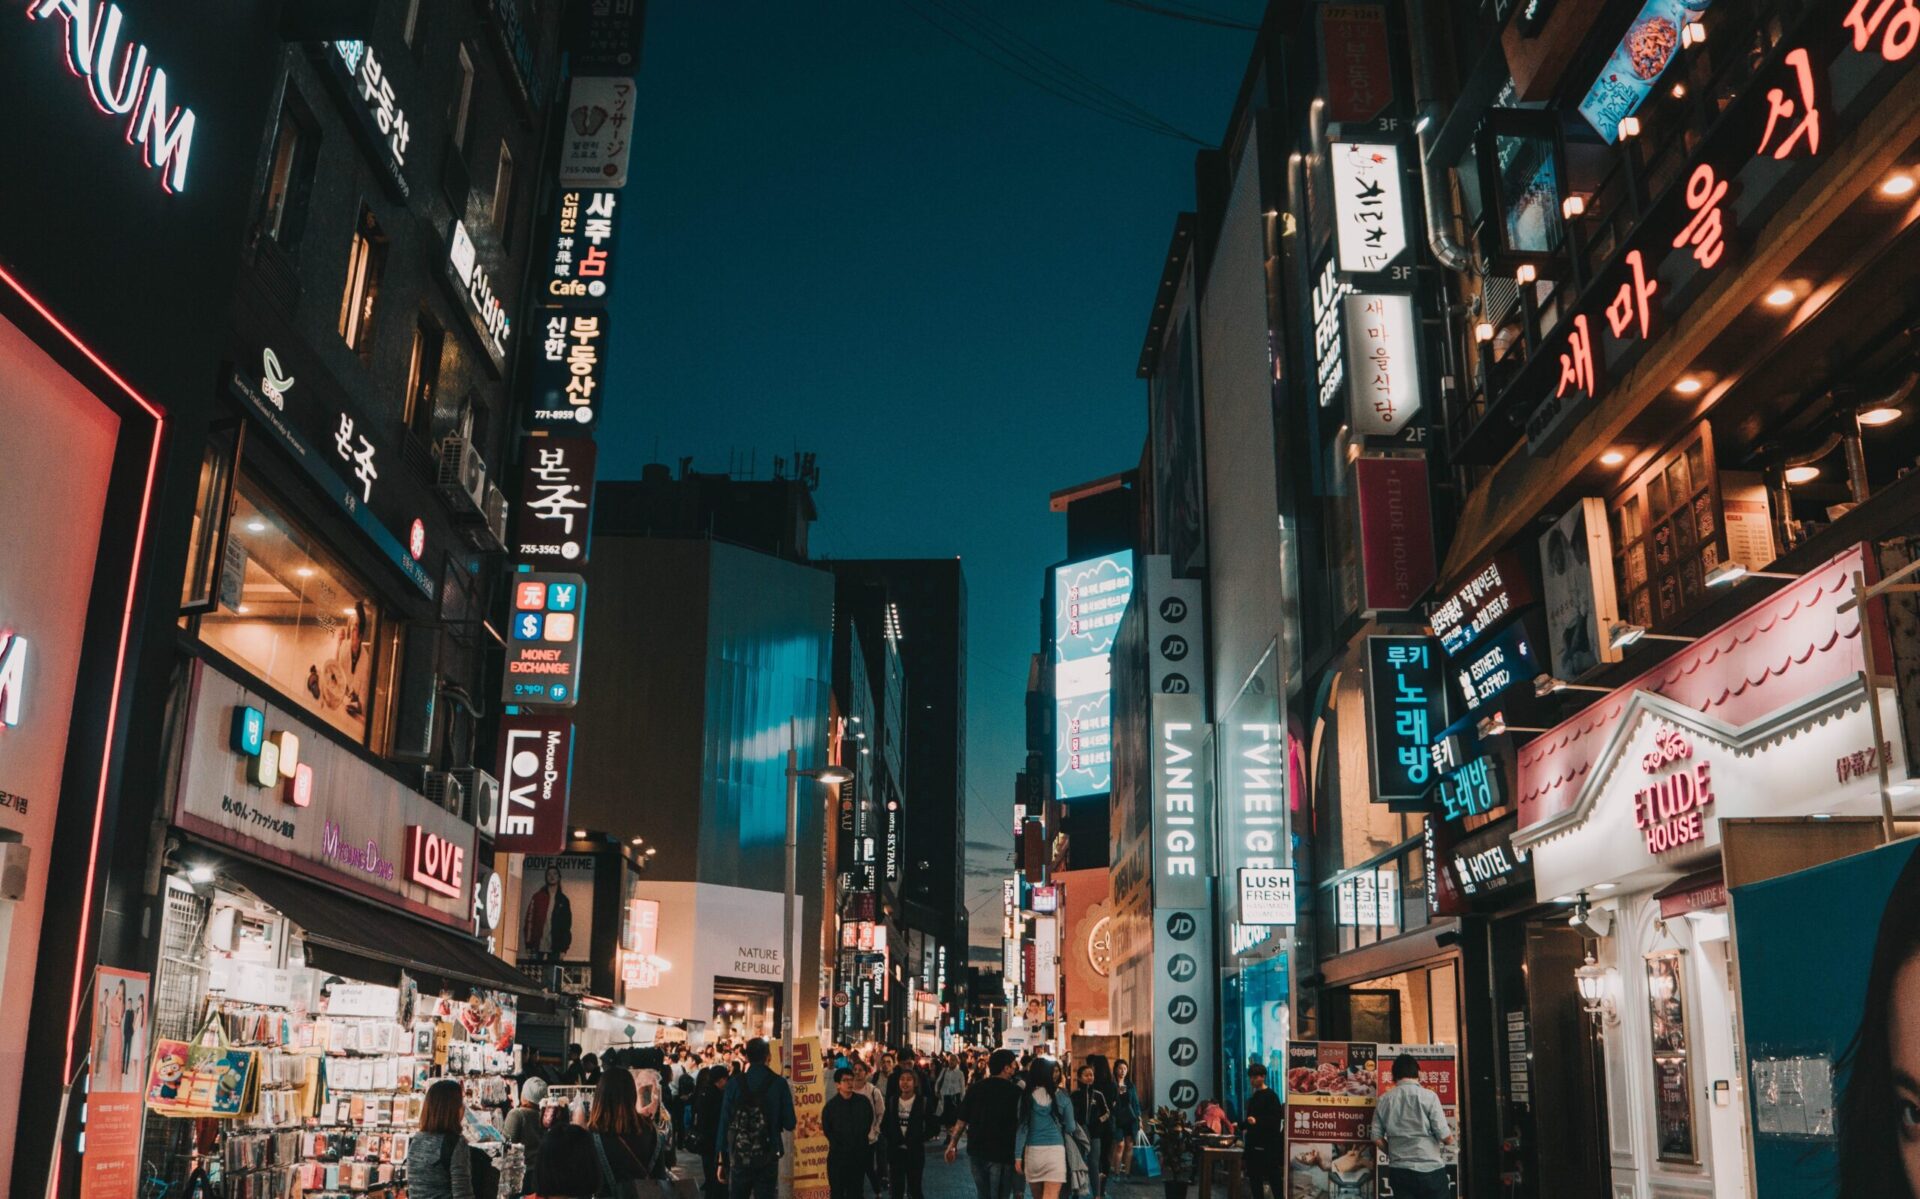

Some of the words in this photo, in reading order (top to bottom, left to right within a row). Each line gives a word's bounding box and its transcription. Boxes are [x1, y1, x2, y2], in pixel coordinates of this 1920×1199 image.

[361, 45, 410, 167] 부동산
[606, 84, 630, 159] マッサージ
[1379, 118, 1398, 131] 3F
[560, 193, 580, 234] 신비안
[1391, 266, 1412, 280] 3F
[549, 279, 586, 296] Cafe
[544, 317, 567, 361] 신한
[566, 317, 600, 405] 부동산
[1365, 299, 1396, 422] 새마을식당
[1406, 427, 1426, 441] 2F
[334, 412, 378, 504] 본죽
[526, 448, 588, 535] 본죽
[520, 543, 561, 555] 755-3562
[1164, 603, 1184, 617] JD
[520, 648, 561, 662] MONEY
[1164, 640, 1185, 655] JD
[1387, 646, 1428, 669] 루키
[1470, 646, 1505, 680] ESTHETIC
[510, 661, 570, 675] EXCHANGE
[553, 687, 565, 697] 1F
[1166, 679, 1187, 693] JD
[1395, 673, 1431, 784] 노래방
[1430, 736, 1455, 775] 루키
[499, 730, 542, 835] LOVE
[1440, 754, 1491, 821] 노래방
[1164, 722, 1195, 876] LANEIGE
[1634, 761, 1714, 830] ETUDE
[1646, 812, 1705, 854] HOUSE
[412, 824, 465, 898] LOVE
[556, 857, 593, 870] RHYME
[886, 833, 896, 879] SKYPARK
[1468, 846, 1512, 882] HOTEL
[1246, 876, 1290, 888] LUSH
[1246, 890, 1291, 901] FRESH
[1691, 888, 1717, 907] ETUDE
[1170, 919, 1193, 934] JD
[738, 946, 779, 961] NATURE
[734, 960, 782, 976] REPUBLIC
[1172, 961, 1194, 976] JD
[1172, 1002, 1194, 1018] JD
[1173, 1045, 1195, 1059] JD
[1173, 1087, 1195, 1102] JD
[1312, 1110, 1336, 1119] Guest
[1338, 1111, 1365, 1121] House
[1312, 1120, 1337, 1129] Hotel
